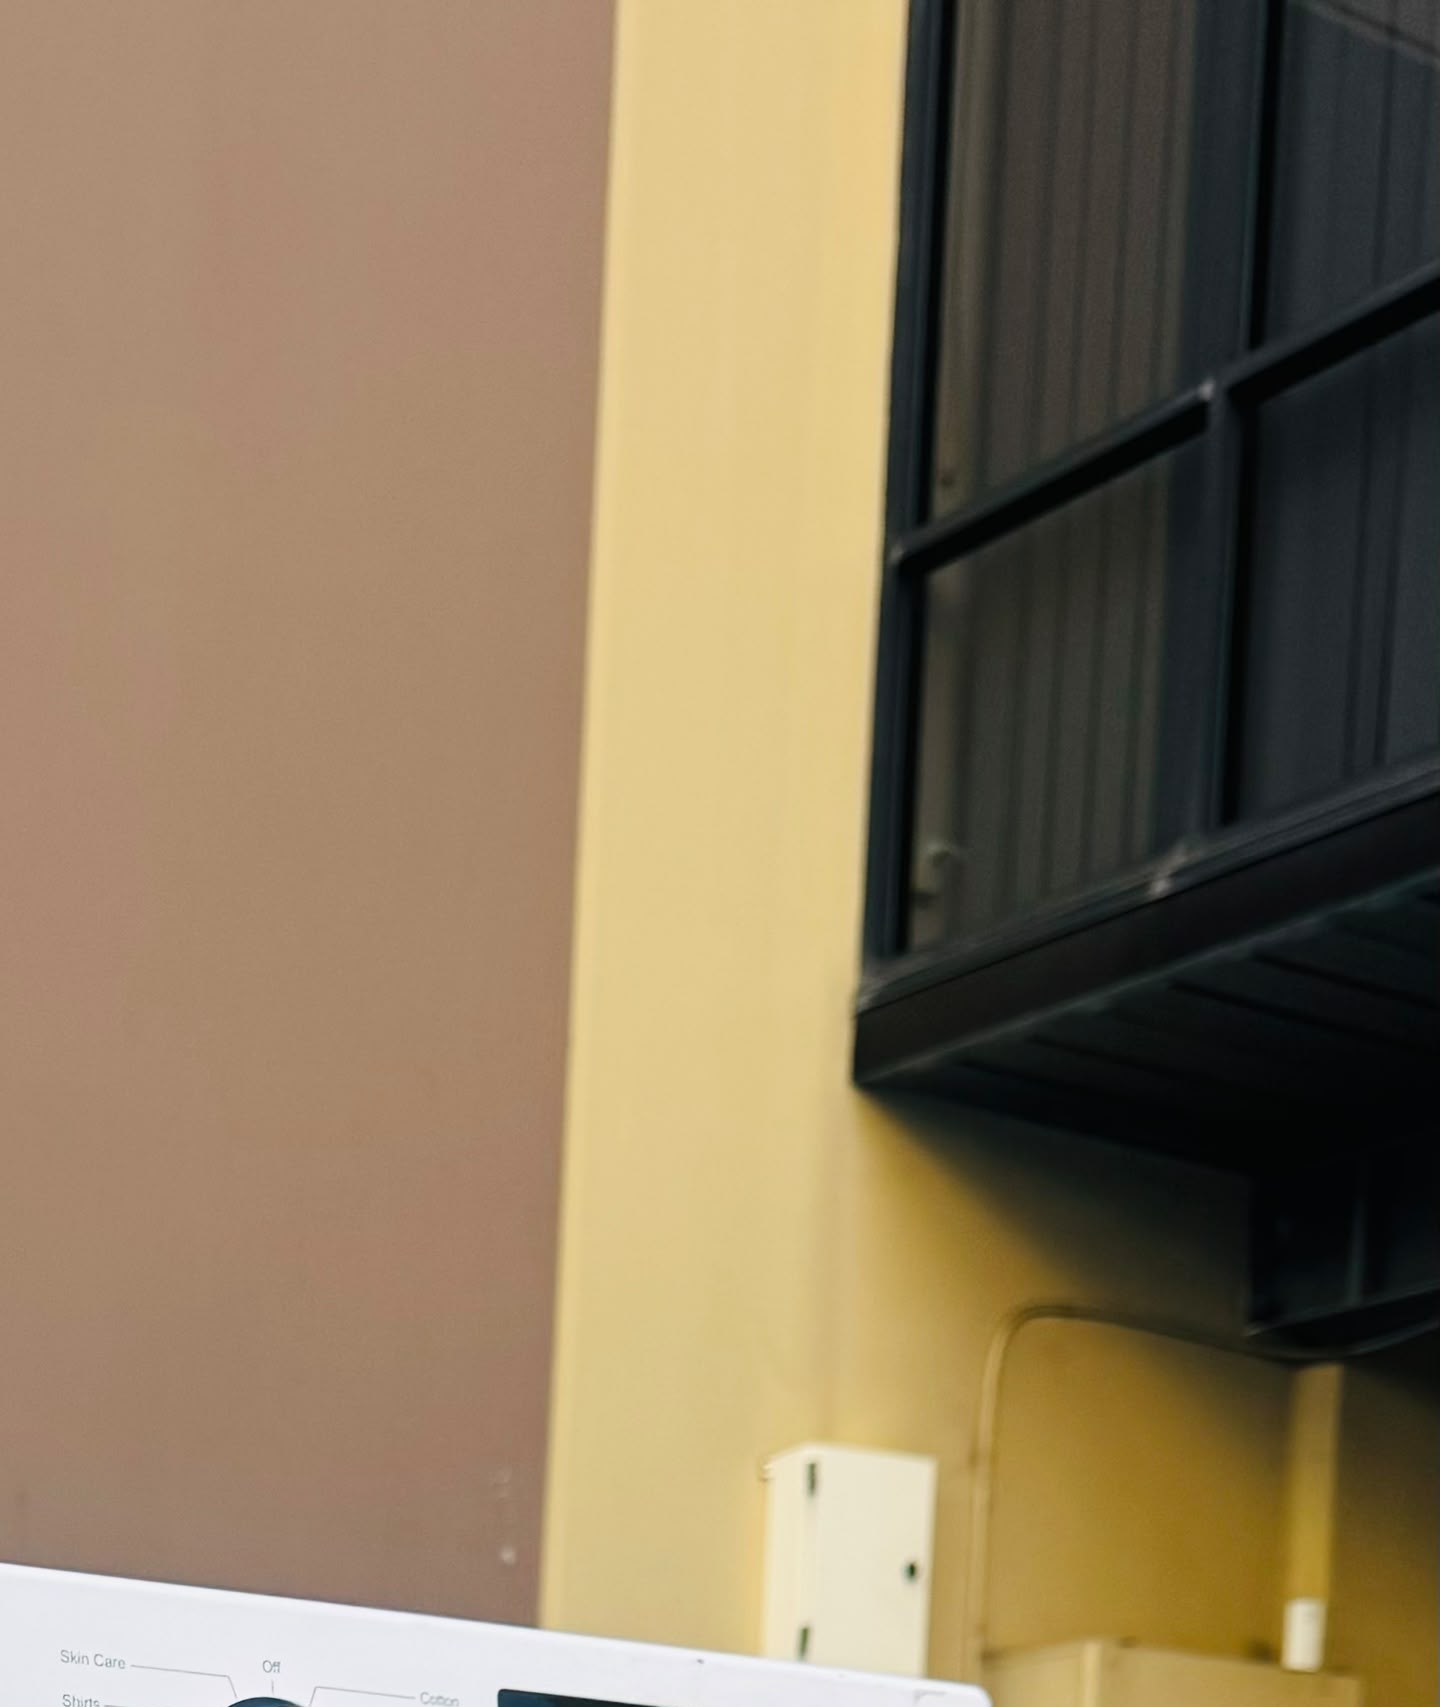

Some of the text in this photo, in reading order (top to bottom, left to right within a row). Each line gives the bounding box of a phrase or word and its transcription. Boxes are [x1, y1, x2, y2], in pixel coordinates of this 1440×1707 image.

[60, 1649, 126, 1669] Skin Care
[262, 1659, 281, 1673] Off
[420, 1691, 460, 1707] Cotton
